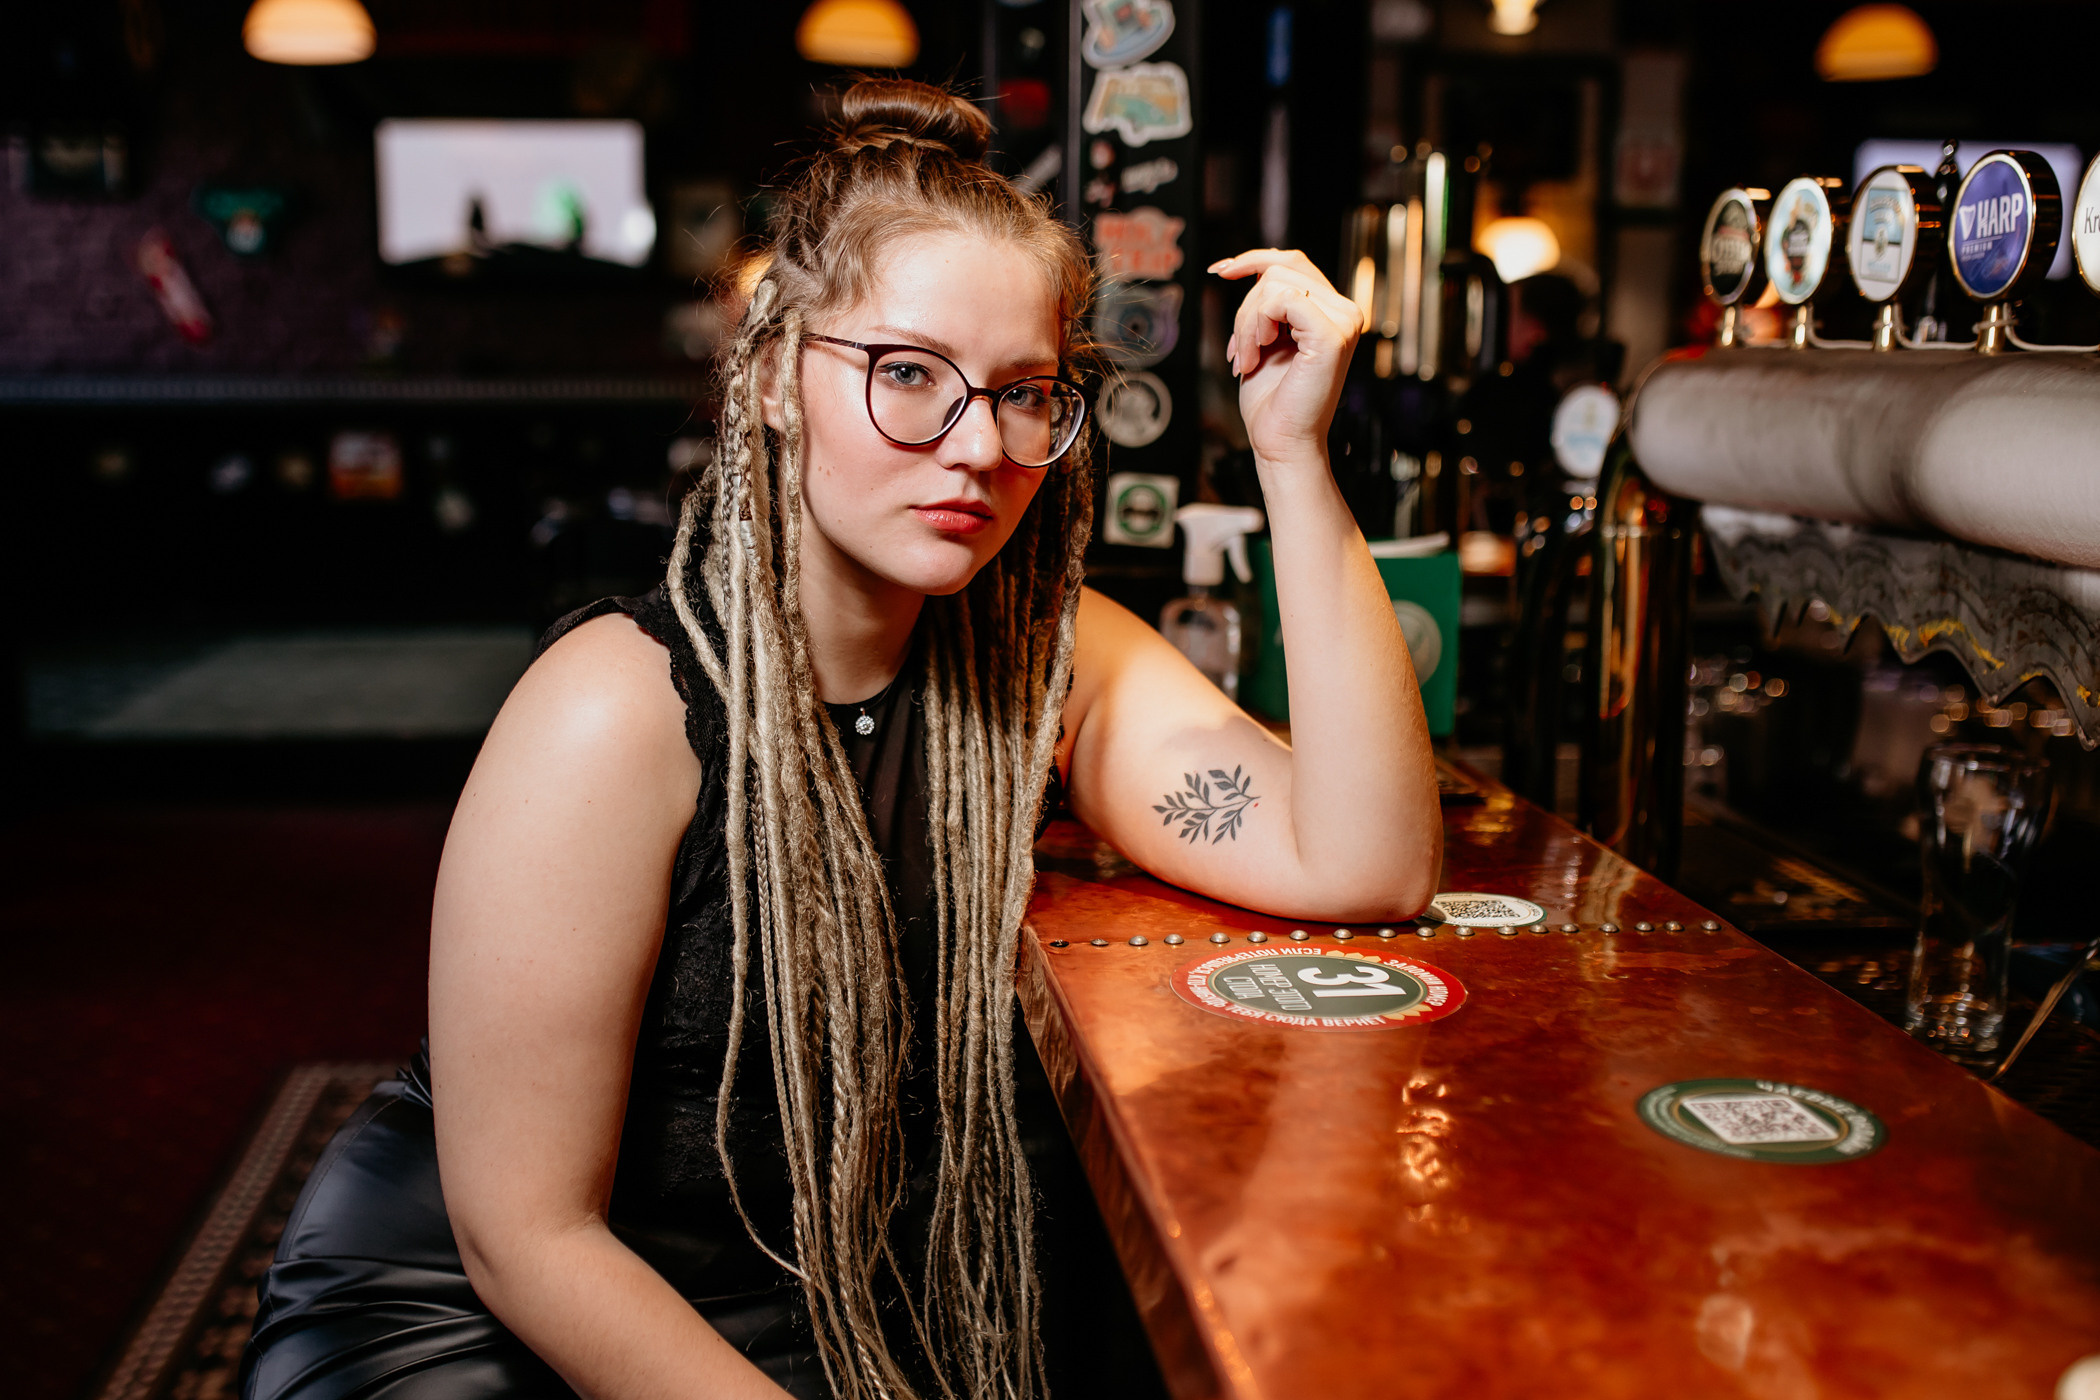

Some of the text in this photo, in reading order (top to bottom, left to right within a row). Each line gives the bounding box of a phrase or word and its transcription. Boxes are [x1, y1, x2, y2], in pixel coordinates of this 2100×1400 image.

[1976, 193, 2024, 239] HARP
[2084, 206, 2100, 234] Kr
[1961, 241, 1993, 255] PREMIUM
[1280, 947, 1322, 955] ЕСЛИ
[1223, 976, 1266, 999] СТОЛА
[1248, 963, 1313, 1011] НОМЕР ЭТОГО
[1297, 965, 1407, 998] 31
[1383, 959, 1449, 1007] ЗАПОМНИ НОМЕР
[1225, 1003, 1266, 1019] ТЕБЯ
[1265, 1012, 1319, 1027] СЮДА
